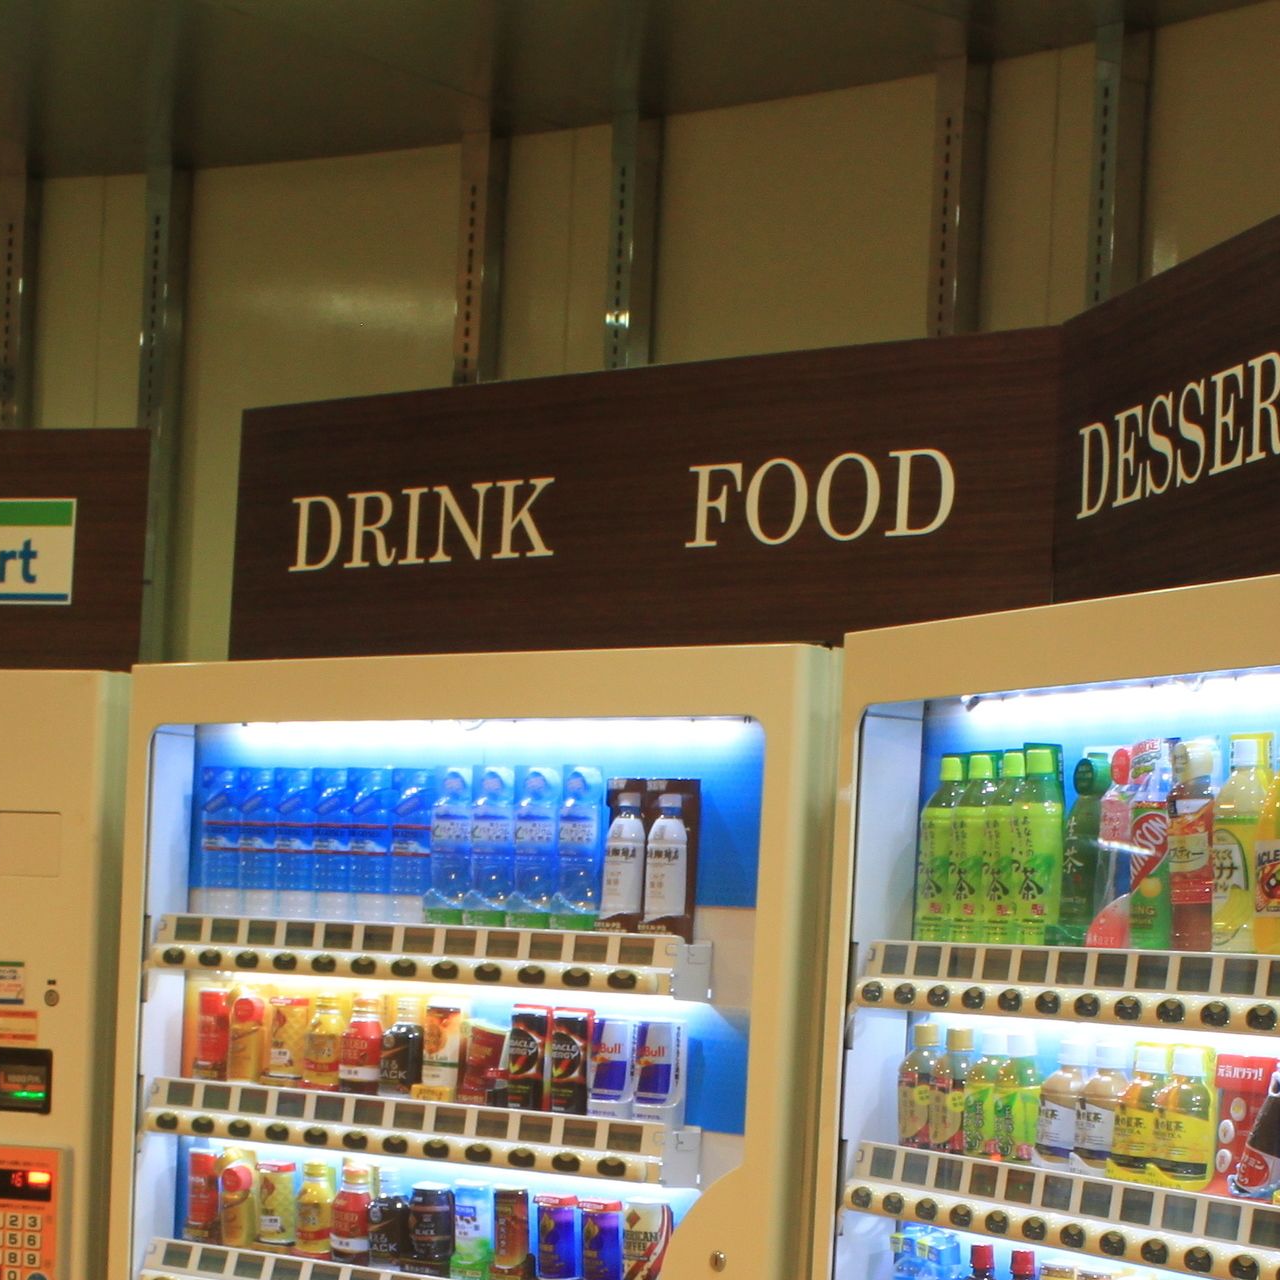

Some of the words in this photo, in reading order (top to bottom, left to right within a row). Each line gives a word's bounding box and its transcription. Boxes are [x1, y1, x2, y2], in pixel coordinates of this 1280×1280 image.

[685, 447, 956, 549] FOOD
[288, 476, 556, 573] DRINK
[1063, 815, 1084, 874] 生茶
[645, 1046, 665, 1057] Bull
[1217, 1064, 1264, 1081] 元気ハツラツ!
[8, 1215, 18, 1226] 2
[28, 1216, 38, 1228] 3
[8, 1233, 18, 1245] 5
[27, 1234, 37, 1246] 6
[8, 1251, 18, 1264] 8
[26, 1253, 37, 1265] 9
